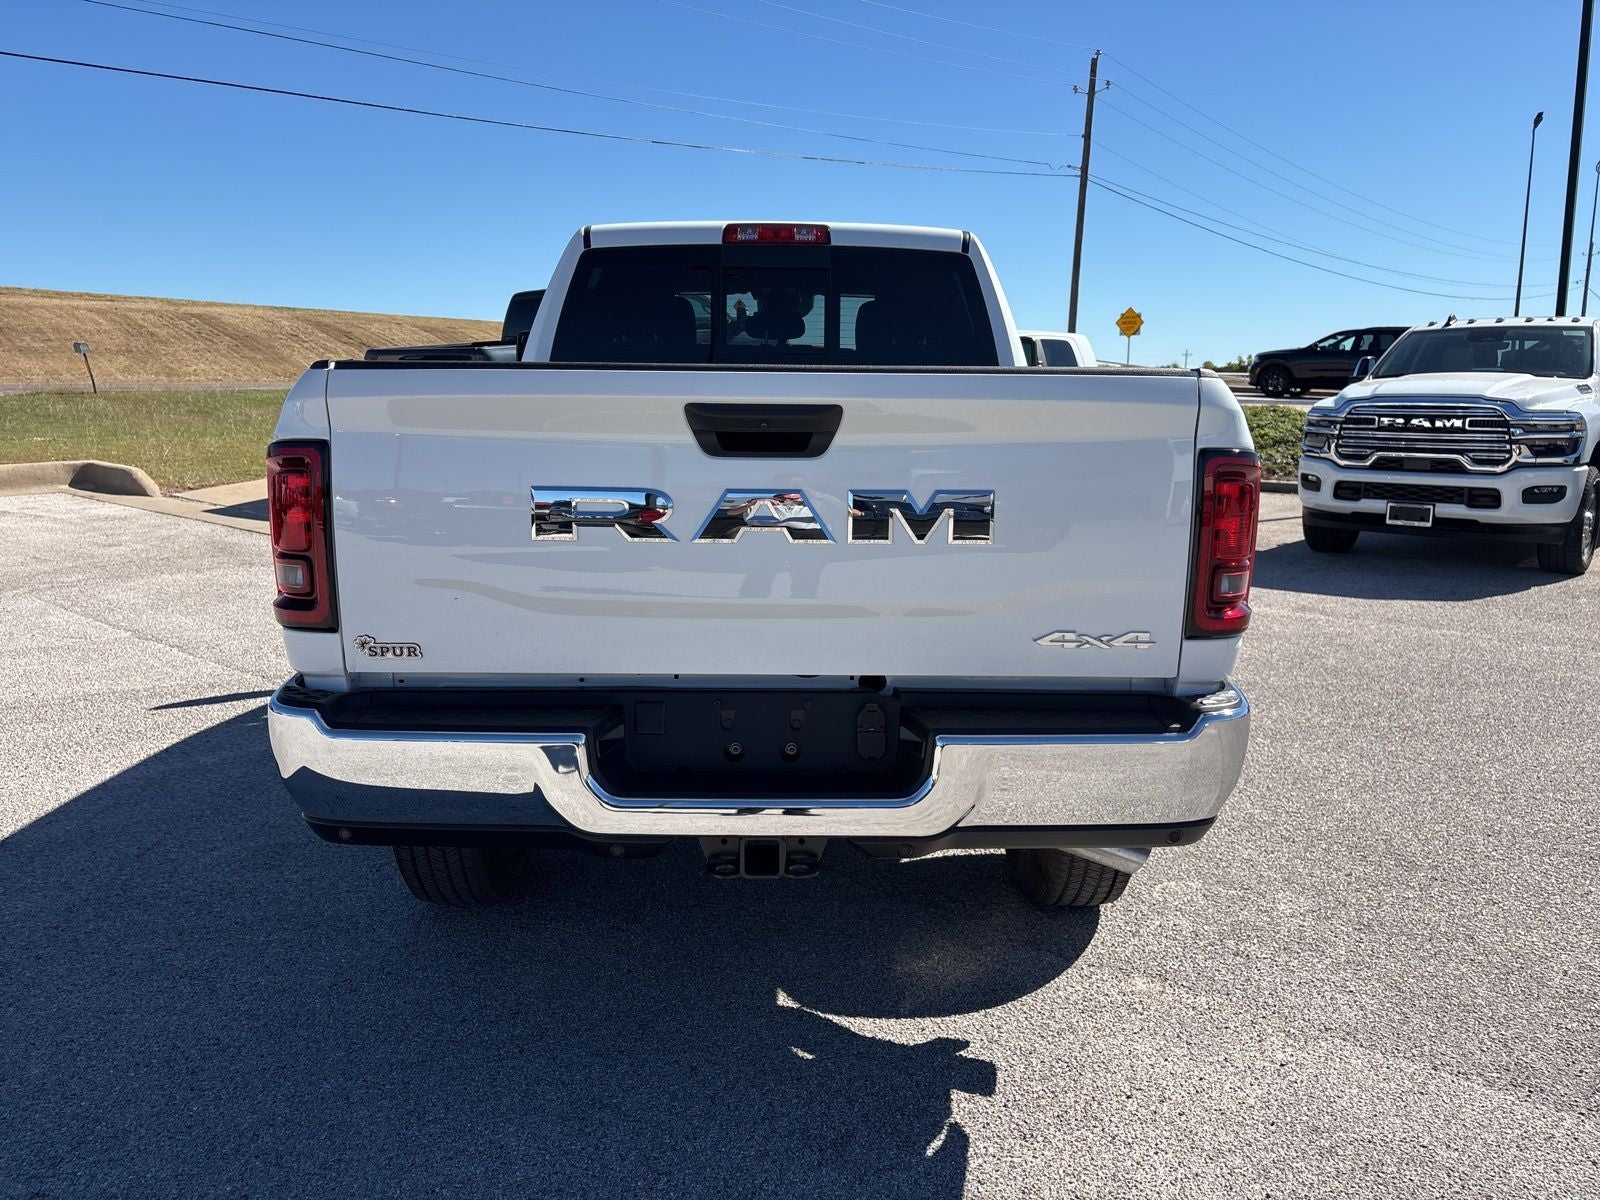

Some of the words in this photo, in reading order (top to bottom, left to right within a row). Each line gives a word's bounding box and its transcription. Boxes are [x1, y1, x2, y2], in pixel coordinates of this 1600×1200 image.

[1380, 417, 1464, 428] RAM
[530, 486, 995, 544] RAM
[368, 645, 419, 657] SPUR
